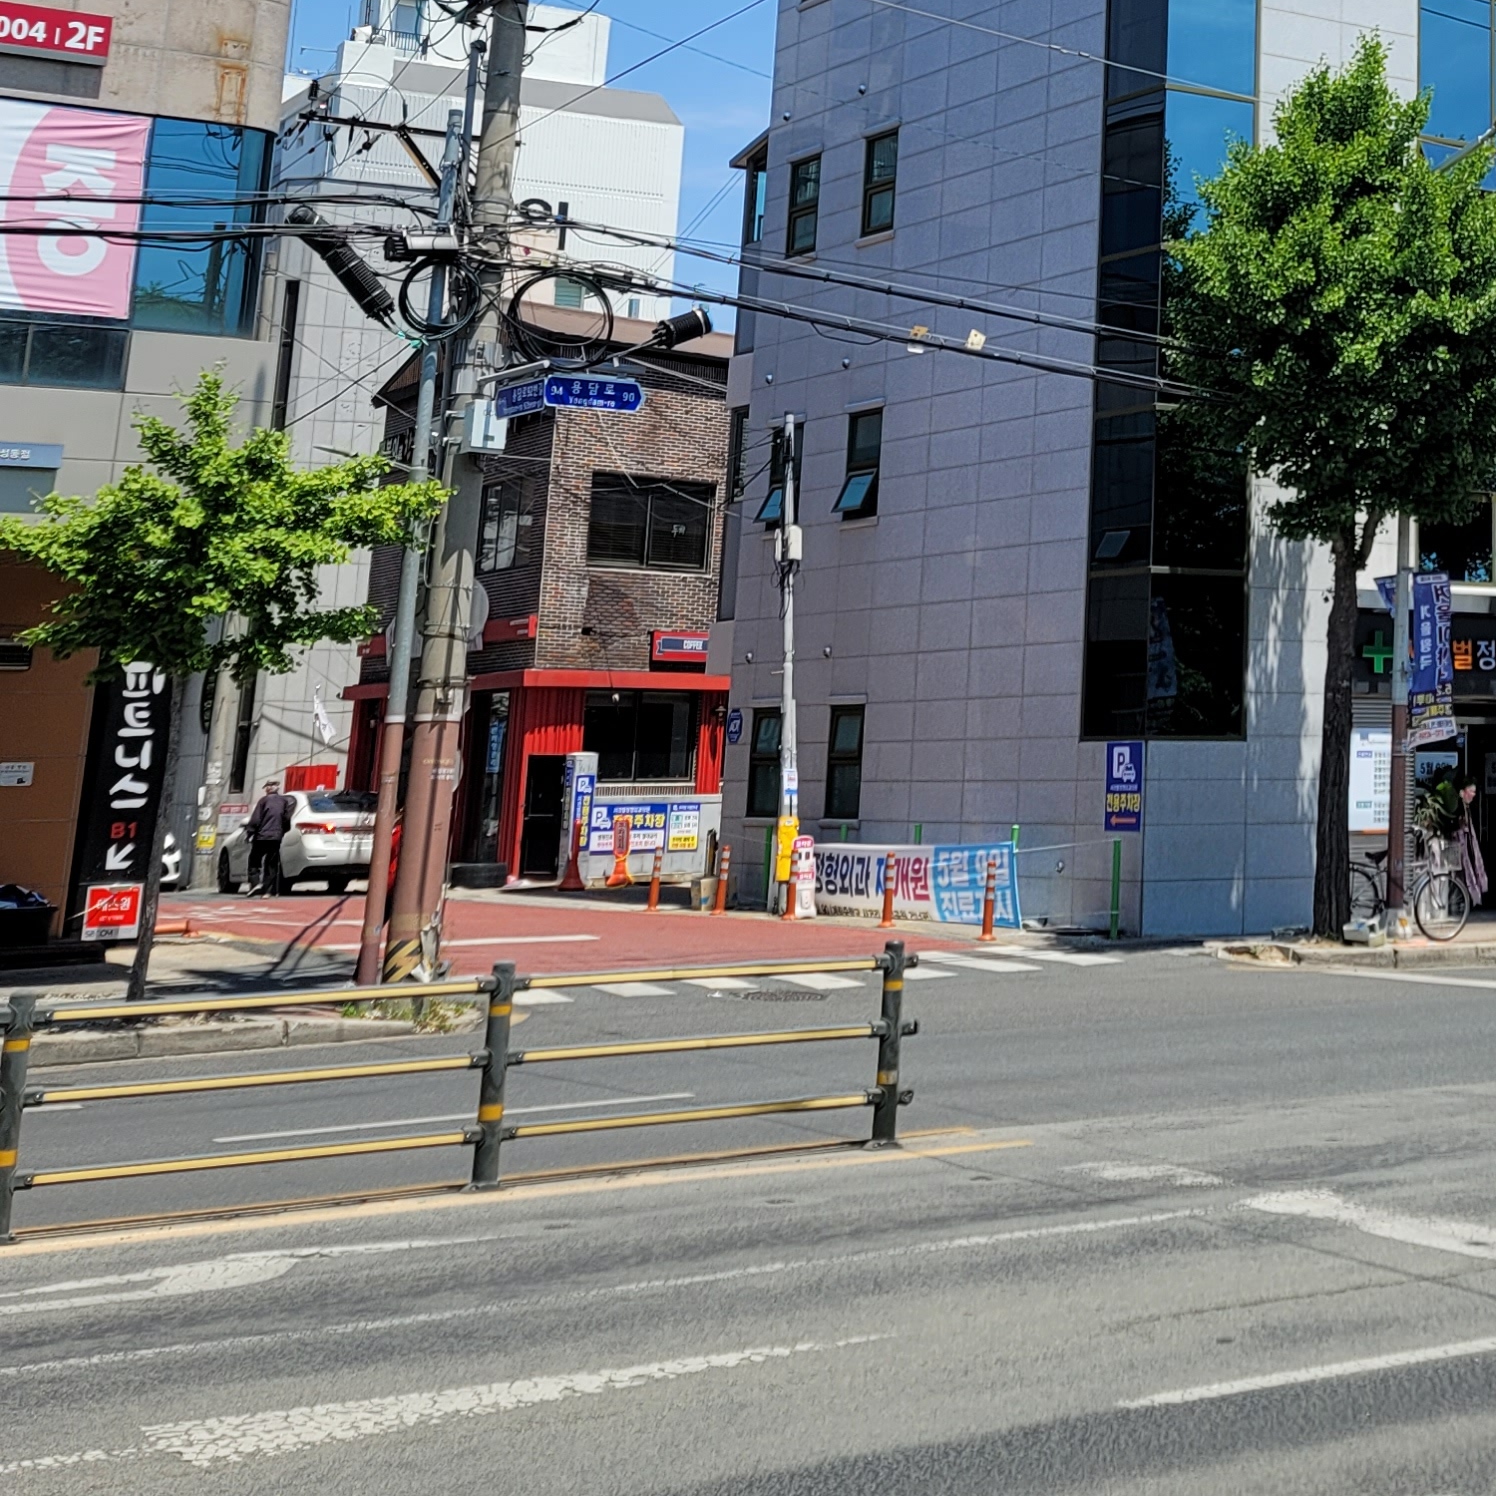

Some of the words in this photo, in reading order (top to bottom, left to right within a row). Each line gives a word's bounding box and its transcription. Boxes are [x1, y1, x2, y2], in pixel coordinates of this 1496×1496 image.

[65, 21, 105, 51] 2F
[550, 385, 563, 396] 94
[571, 380, 615, 396] 용담로
[622, 391, 635, 402] 90
[683, 639, 703, 651] COFFEE
[1106, 792, 1141, 813] 전용주차장
[110, 822, 138, 840] B1
[936, 850, 969, 887] 5월
